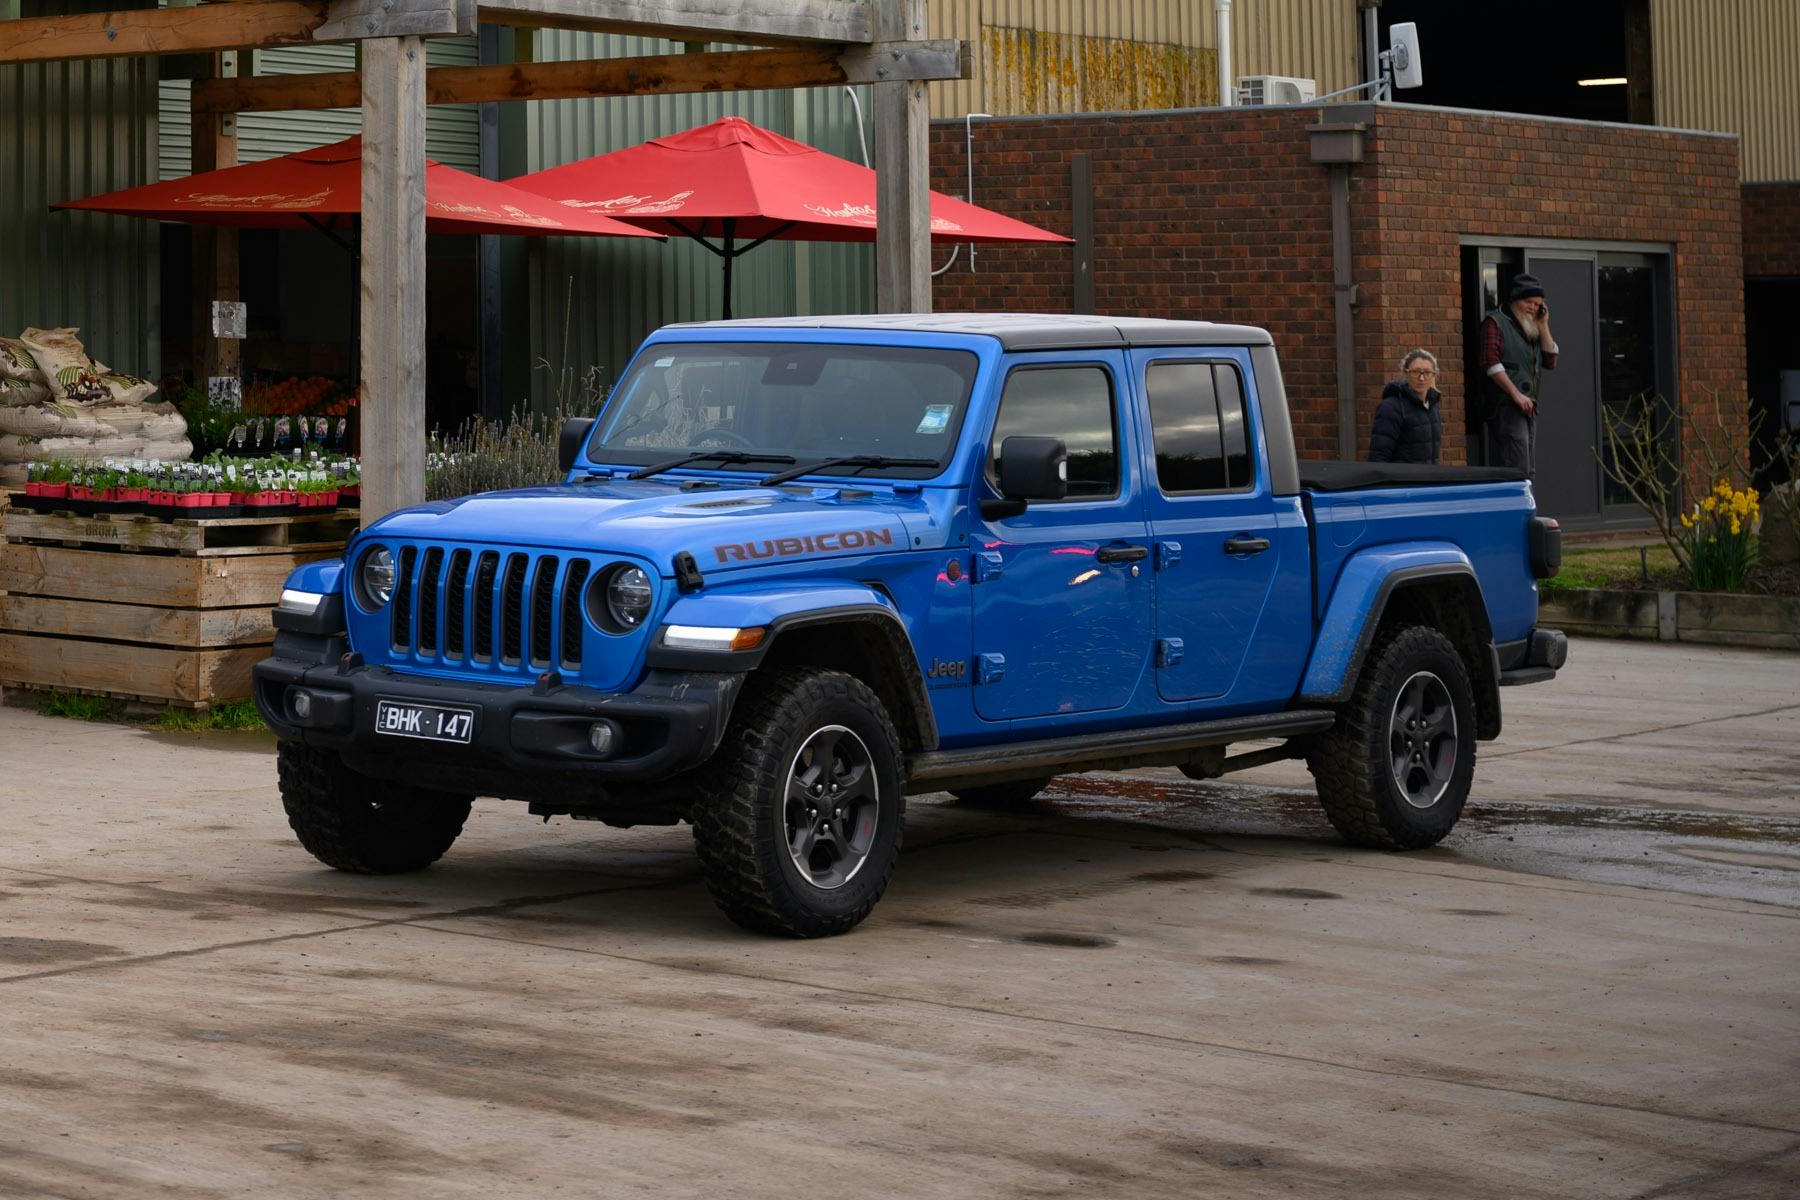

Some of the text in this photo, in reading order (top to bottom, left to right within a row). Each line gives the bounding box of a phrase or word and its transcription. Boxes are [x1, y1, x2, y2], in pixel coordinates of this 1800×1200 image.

[714, 528, 893, 564] RUBICON
[927, 657, 966, 680] Jeep
[386, 707, 471, 738] BHK 147
